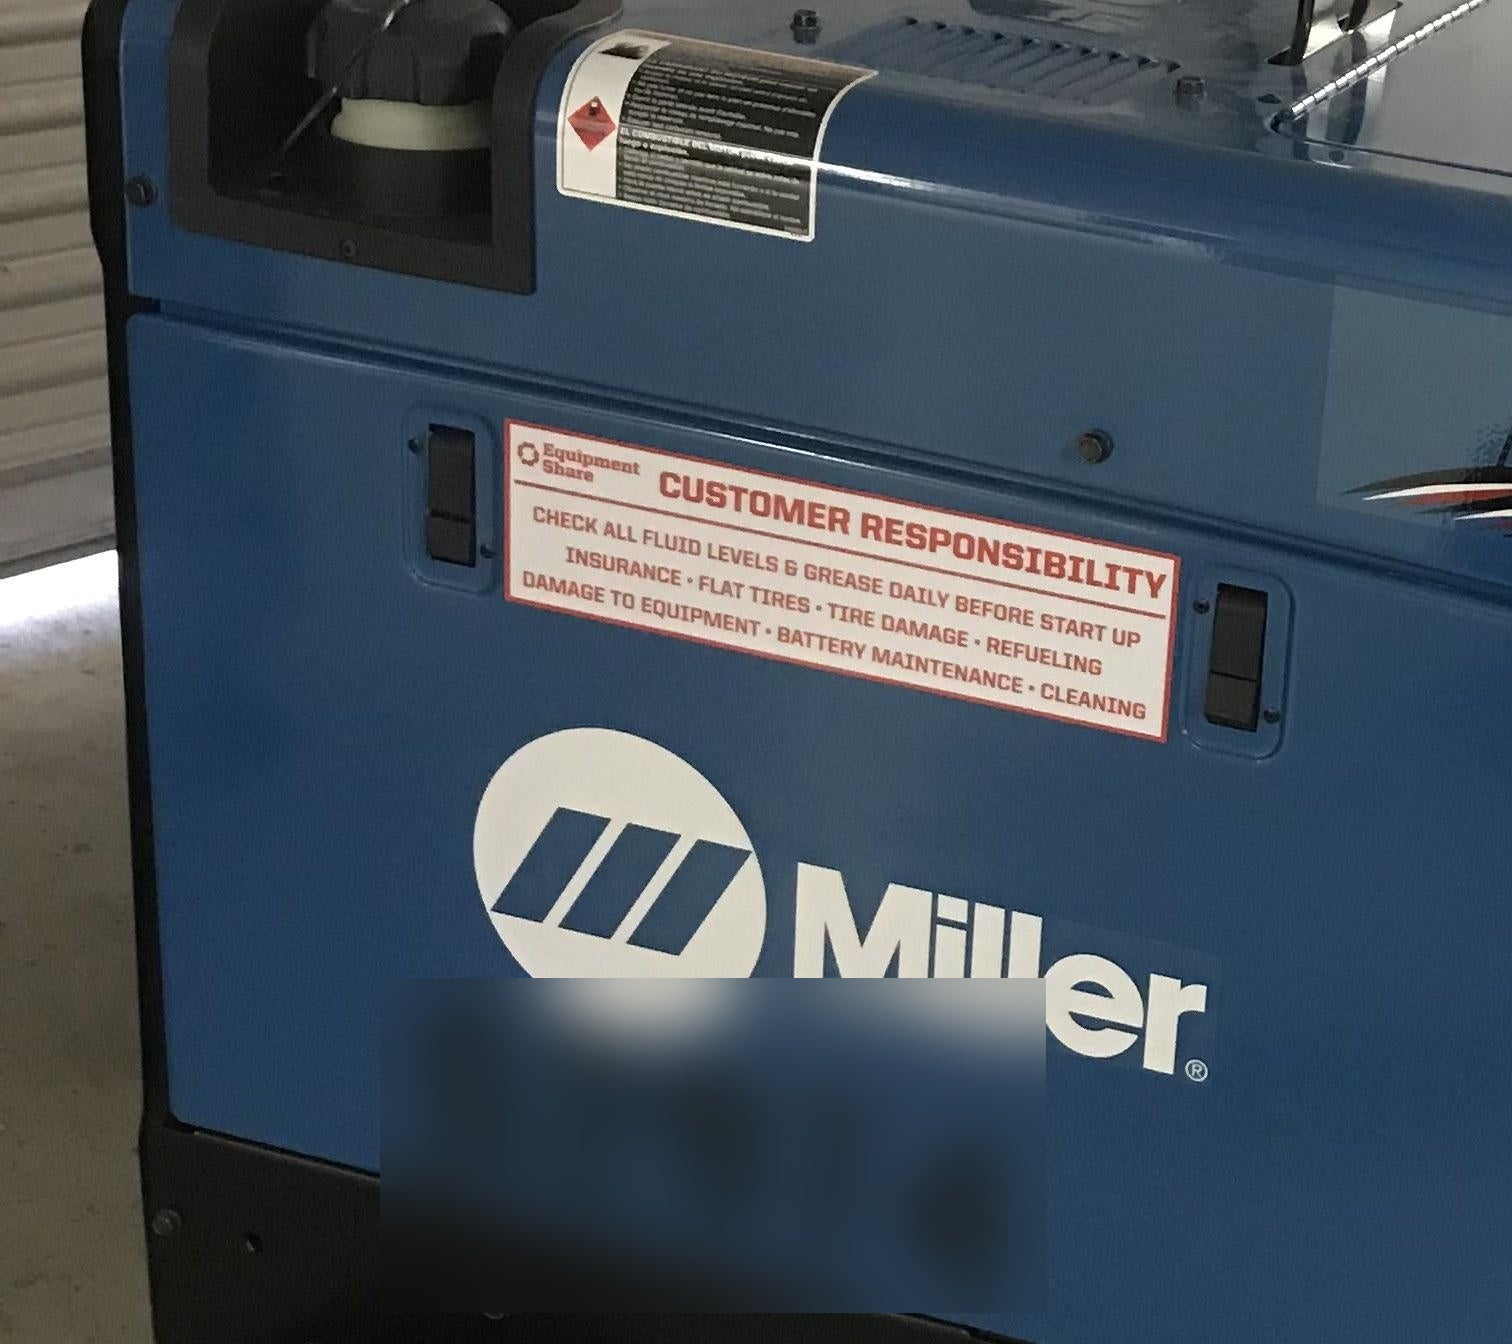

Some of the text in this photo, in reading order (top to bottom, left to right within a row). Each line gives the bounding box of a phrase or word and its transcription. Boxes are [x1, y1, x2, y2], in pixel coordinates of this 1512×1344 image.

[543, 442, 641, 476] Equipment
[543, 459, 595, 483] Share
[533, 505, 1141, 649] CHECK ALL FLUID LEVELS & GREASE DAILY BEFORE START UP
[659, 470, 1167, 599] CUSTOMER RESPONSIBILITY
[523, 570, 1147, 720] DAMAGE TO EQUIPMENT BATTERY MAINTENANCE CLEANING
[565, 546, 1102, 676] INSURANCE FLAT TIRES TIRE DAMAGE REFUELING
